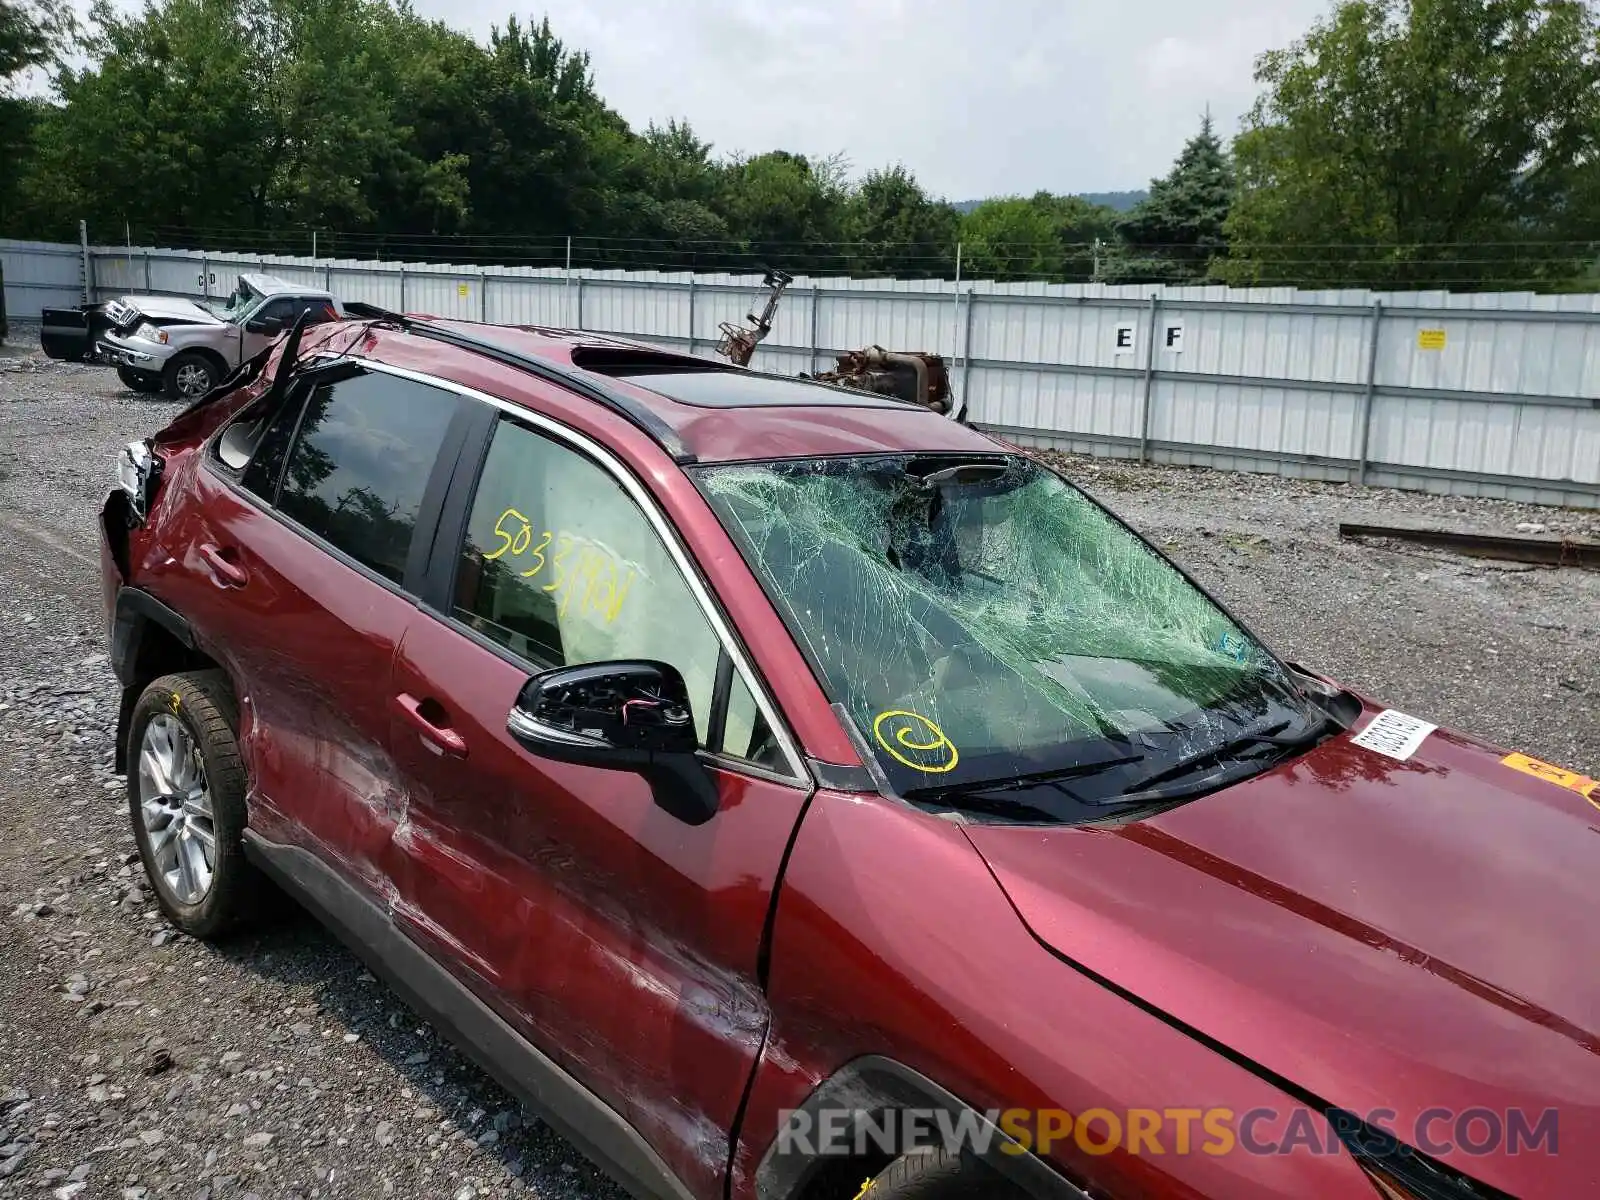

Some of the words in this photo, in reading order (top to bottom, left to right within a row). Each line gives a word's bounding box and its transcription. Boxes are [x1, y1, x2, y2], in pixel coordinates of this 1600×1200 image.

[210, 273, 216, 285] D
[1117, 328, 1132, 347] E
[1166, 327, 1182, 346] F
